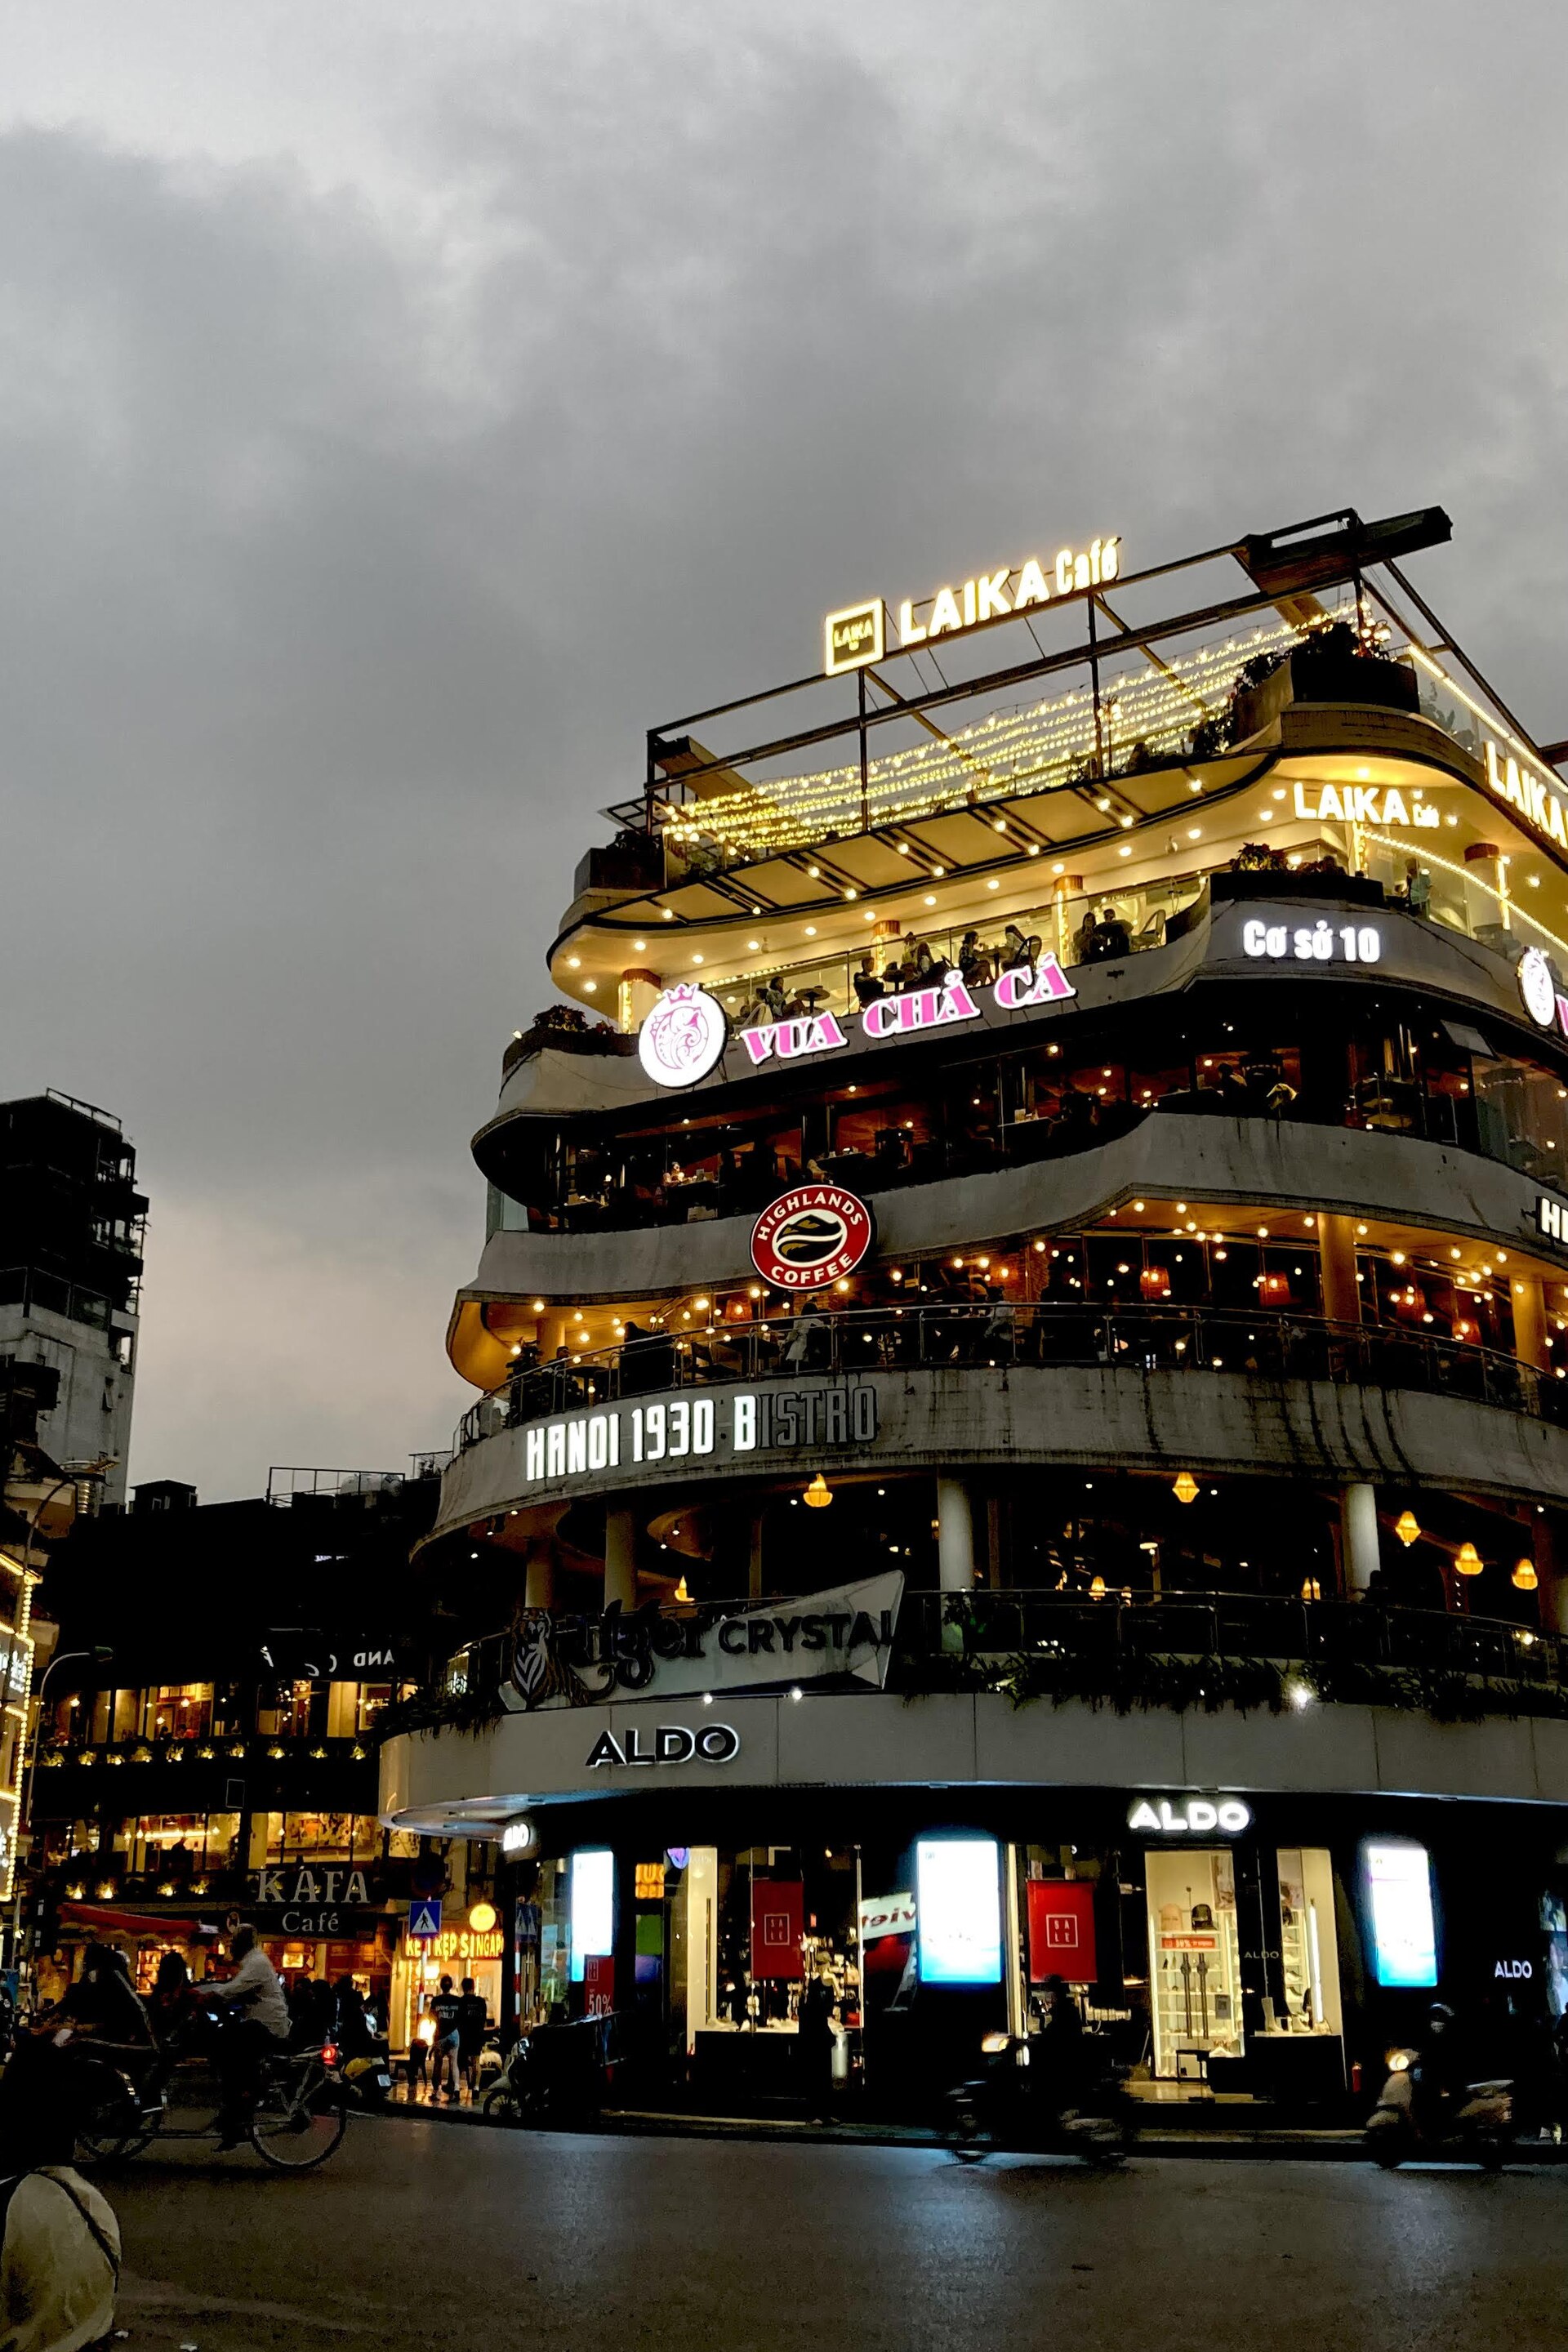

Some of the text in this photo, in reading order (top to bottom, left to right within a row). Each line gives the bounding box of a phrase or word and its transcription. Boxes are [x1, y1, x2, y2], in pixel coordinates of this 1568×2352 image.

[900, 537, 1120, 645] LAIKA Café
[1294, 782, 1410, 825] LAIKA
[1484, 741, 1567, 849] LAIKA
[1243, 920, 1381, 963] Cơ sở 10
[741, 951, 1077, 1065] VUA CHẢ CÁ
[757, 1192, 863, 1241] HIGHLANDS
[771, 1253, 853, 1285] COFFEE
[526, 1385, 879, 1481] HANOI 1930 BISTRO
[717, 1609, 903, 1655] CRYSTAL
[585, 1723, 741, 1767] ALDO
[1129, 1802, 1250, 1832] ALDO
[282, 1911, 339, 1932] Café
[1244, 1950, 1280, 1959] ALDO
[1494, 1960, 1532, 1978] ALDO
